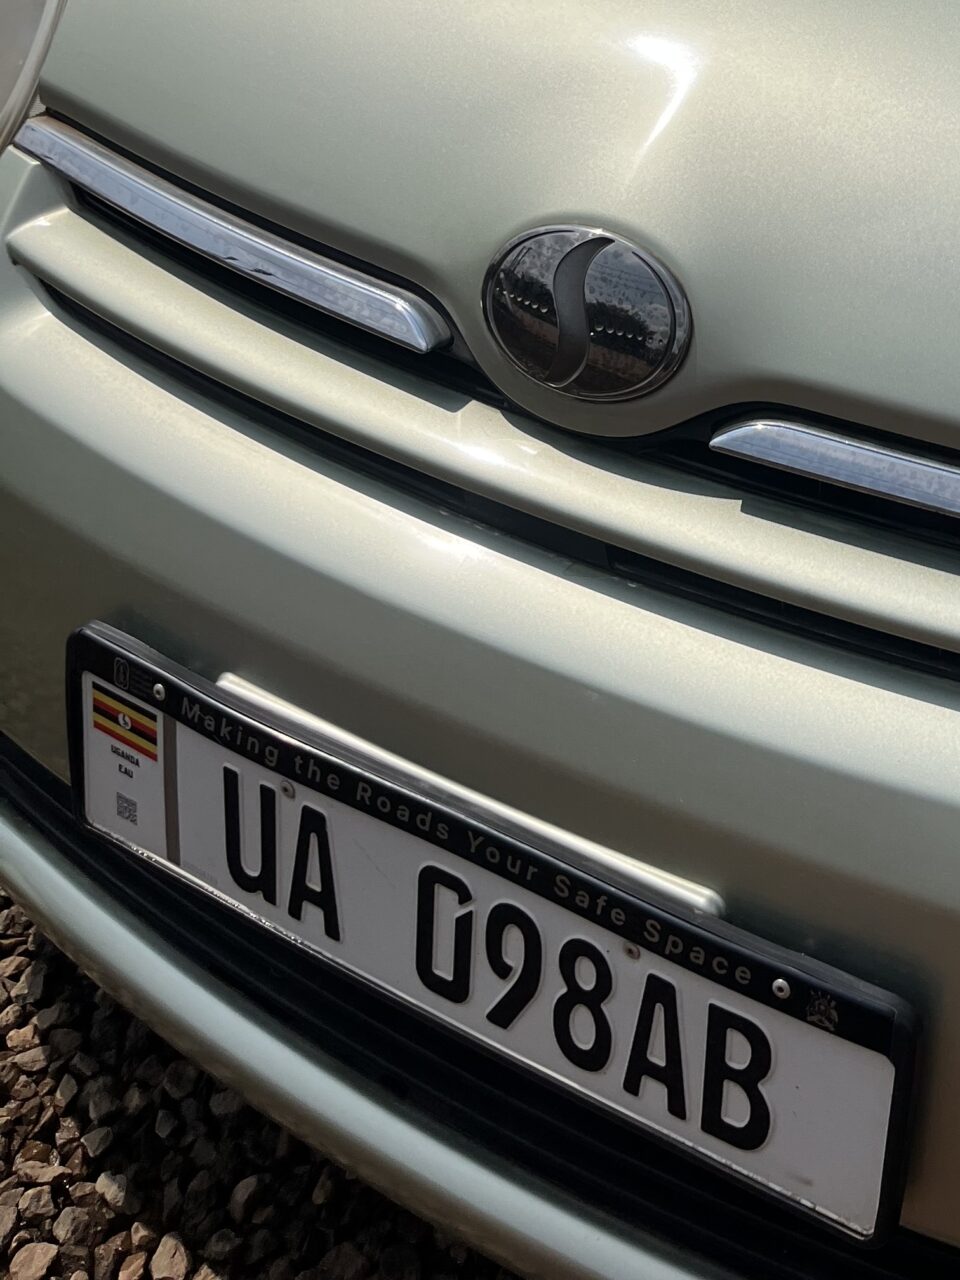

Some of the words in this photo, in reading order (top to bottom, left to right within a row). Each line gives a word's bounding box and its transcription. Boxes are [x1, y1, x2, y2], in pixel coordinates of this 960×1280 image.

[111, 743, 141, 769] UGANDA
[181, 696, 279, 767] Making
[294, 755, 341, 790] the
[356, 781, 449, 840] Roads
[467, 830, 539, 881] Your
[554, 874, 626, 926] Safe
[643, 919, 752, 985] Space
[223, 765, 341, 943] UA
[416, 865, 773, 1151] 098AB
